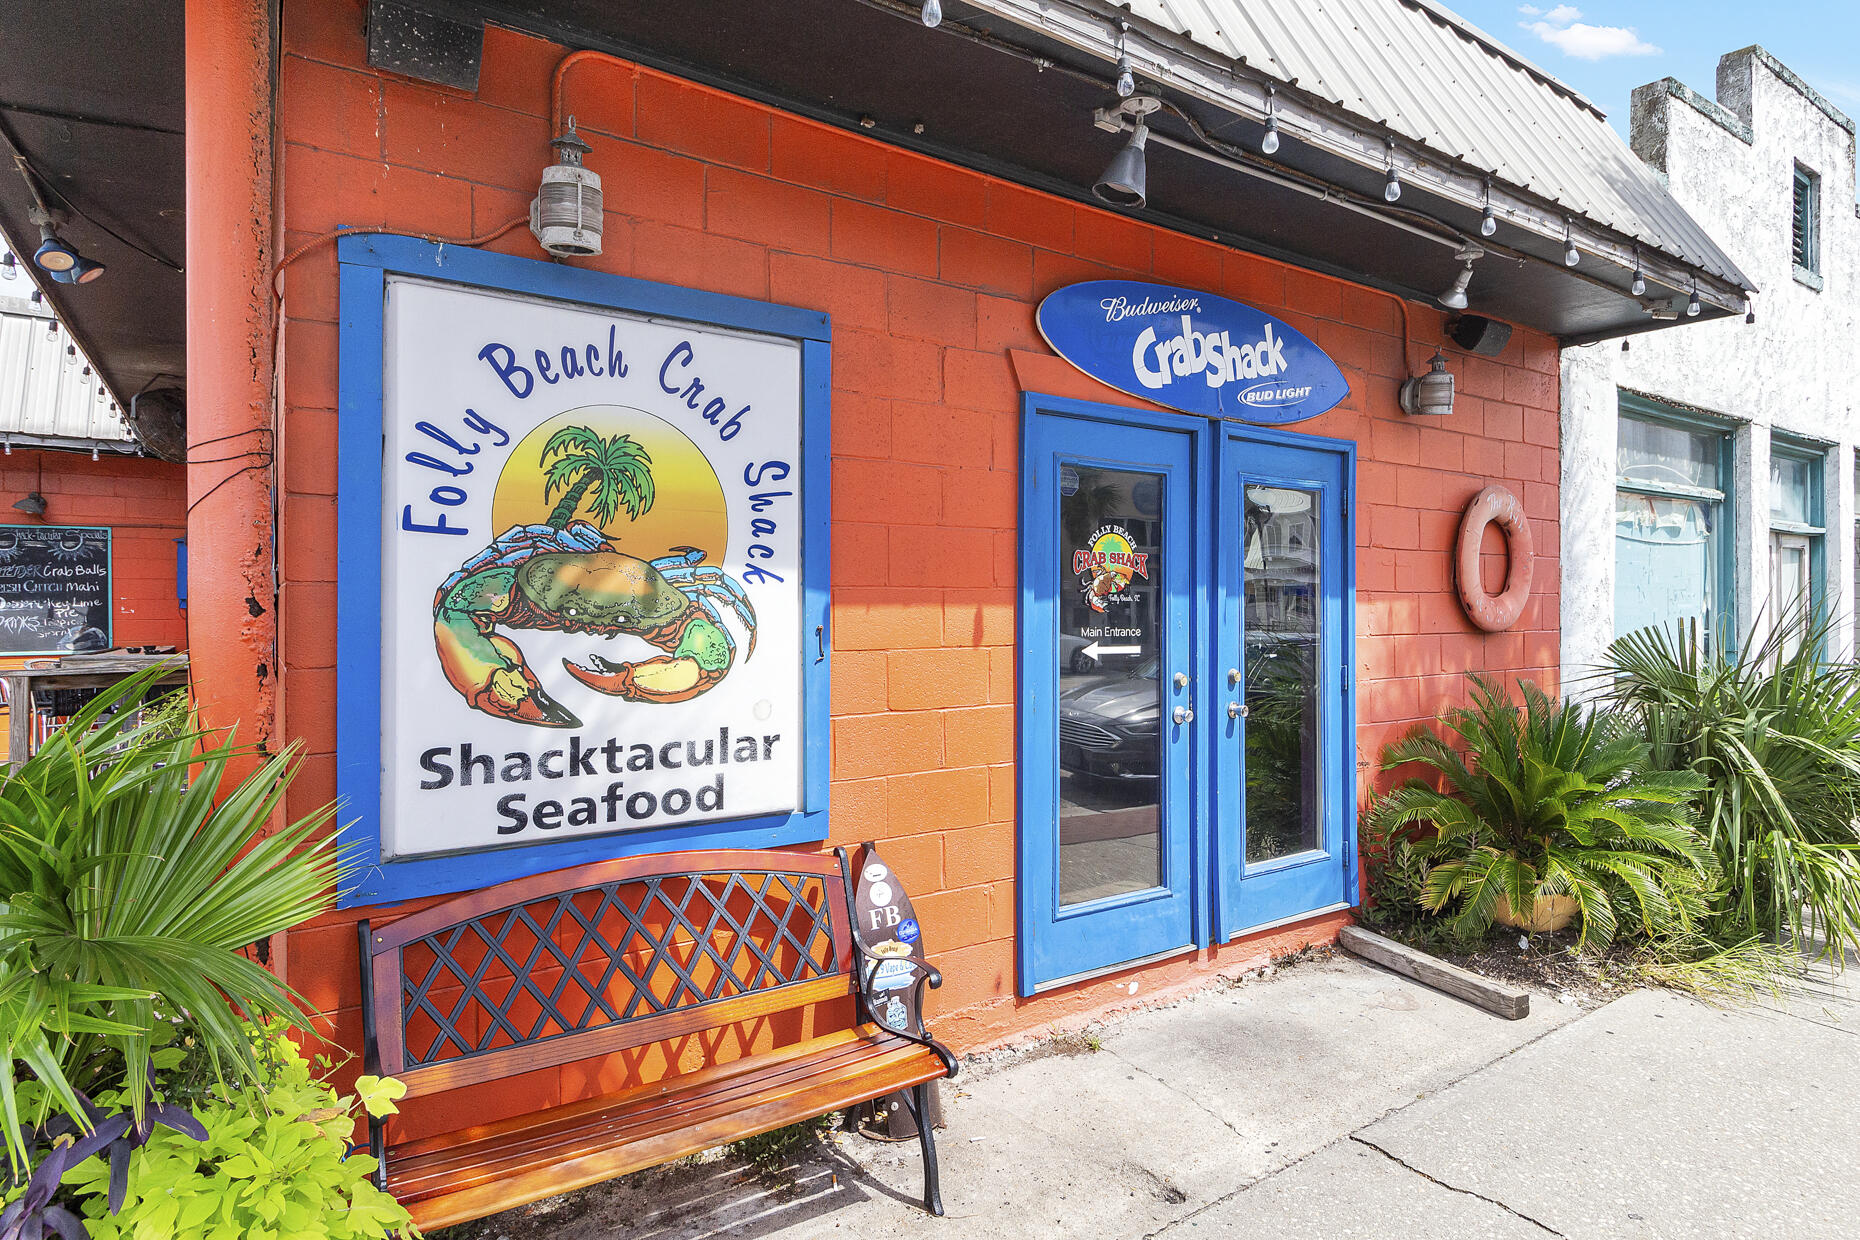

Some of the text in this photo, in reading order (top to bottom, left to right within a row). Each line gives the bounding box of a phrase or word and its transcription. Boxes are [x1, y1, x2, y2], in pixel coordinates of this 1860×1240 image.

[1100, 294, 1199, 323] Budweiser
[1246, 386, 1312, 402] BUD LIGHT
[402, 323, 793, 585] Folly Beach Crab Shack
[1088, 525, 1138, 551] FOLLY BEACH
[43, 564, 73, 577] Crab
[75, 563, 107, 576] Balls
[1073, 550, 1149, 580] CRAB SHACK
[72, 597, 102, 607] Lime
[1081, 626, 1142, 638] Main Entrance
[419, 726, 781, 791] Shacktacular
[496, 773, 725, 835] Seafood
[868, 905, 901, 931] FB
